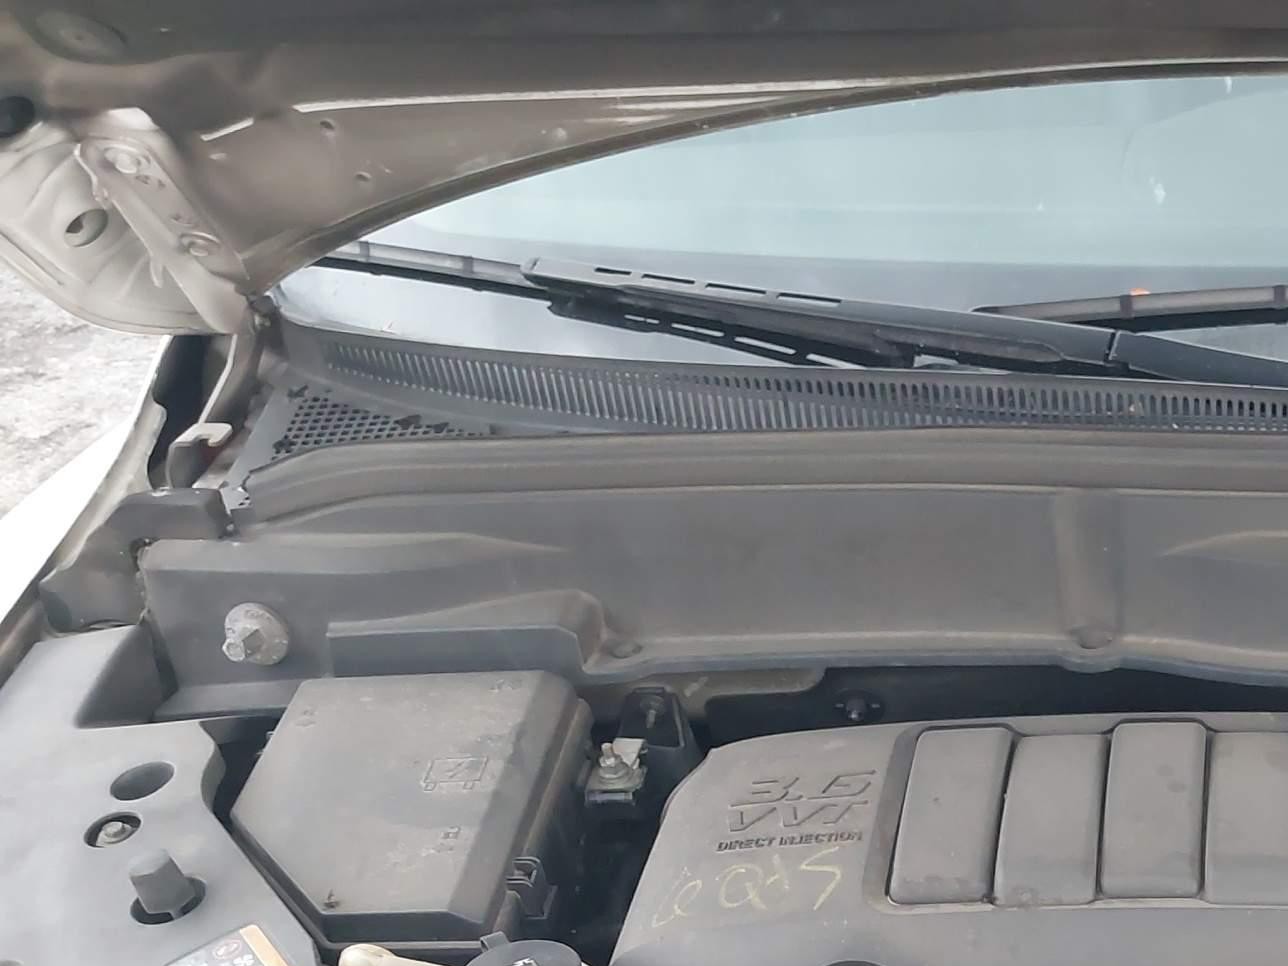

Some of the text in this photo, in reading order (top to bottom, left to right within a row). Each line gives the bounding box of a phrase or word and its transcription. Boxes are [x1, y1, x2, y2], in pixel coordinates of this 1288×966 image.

[729, 769, 877, 807] 3.6
[727, 799, 869, 833] VVT
[716, 830, 864, 852] DIRECT INJECTION
